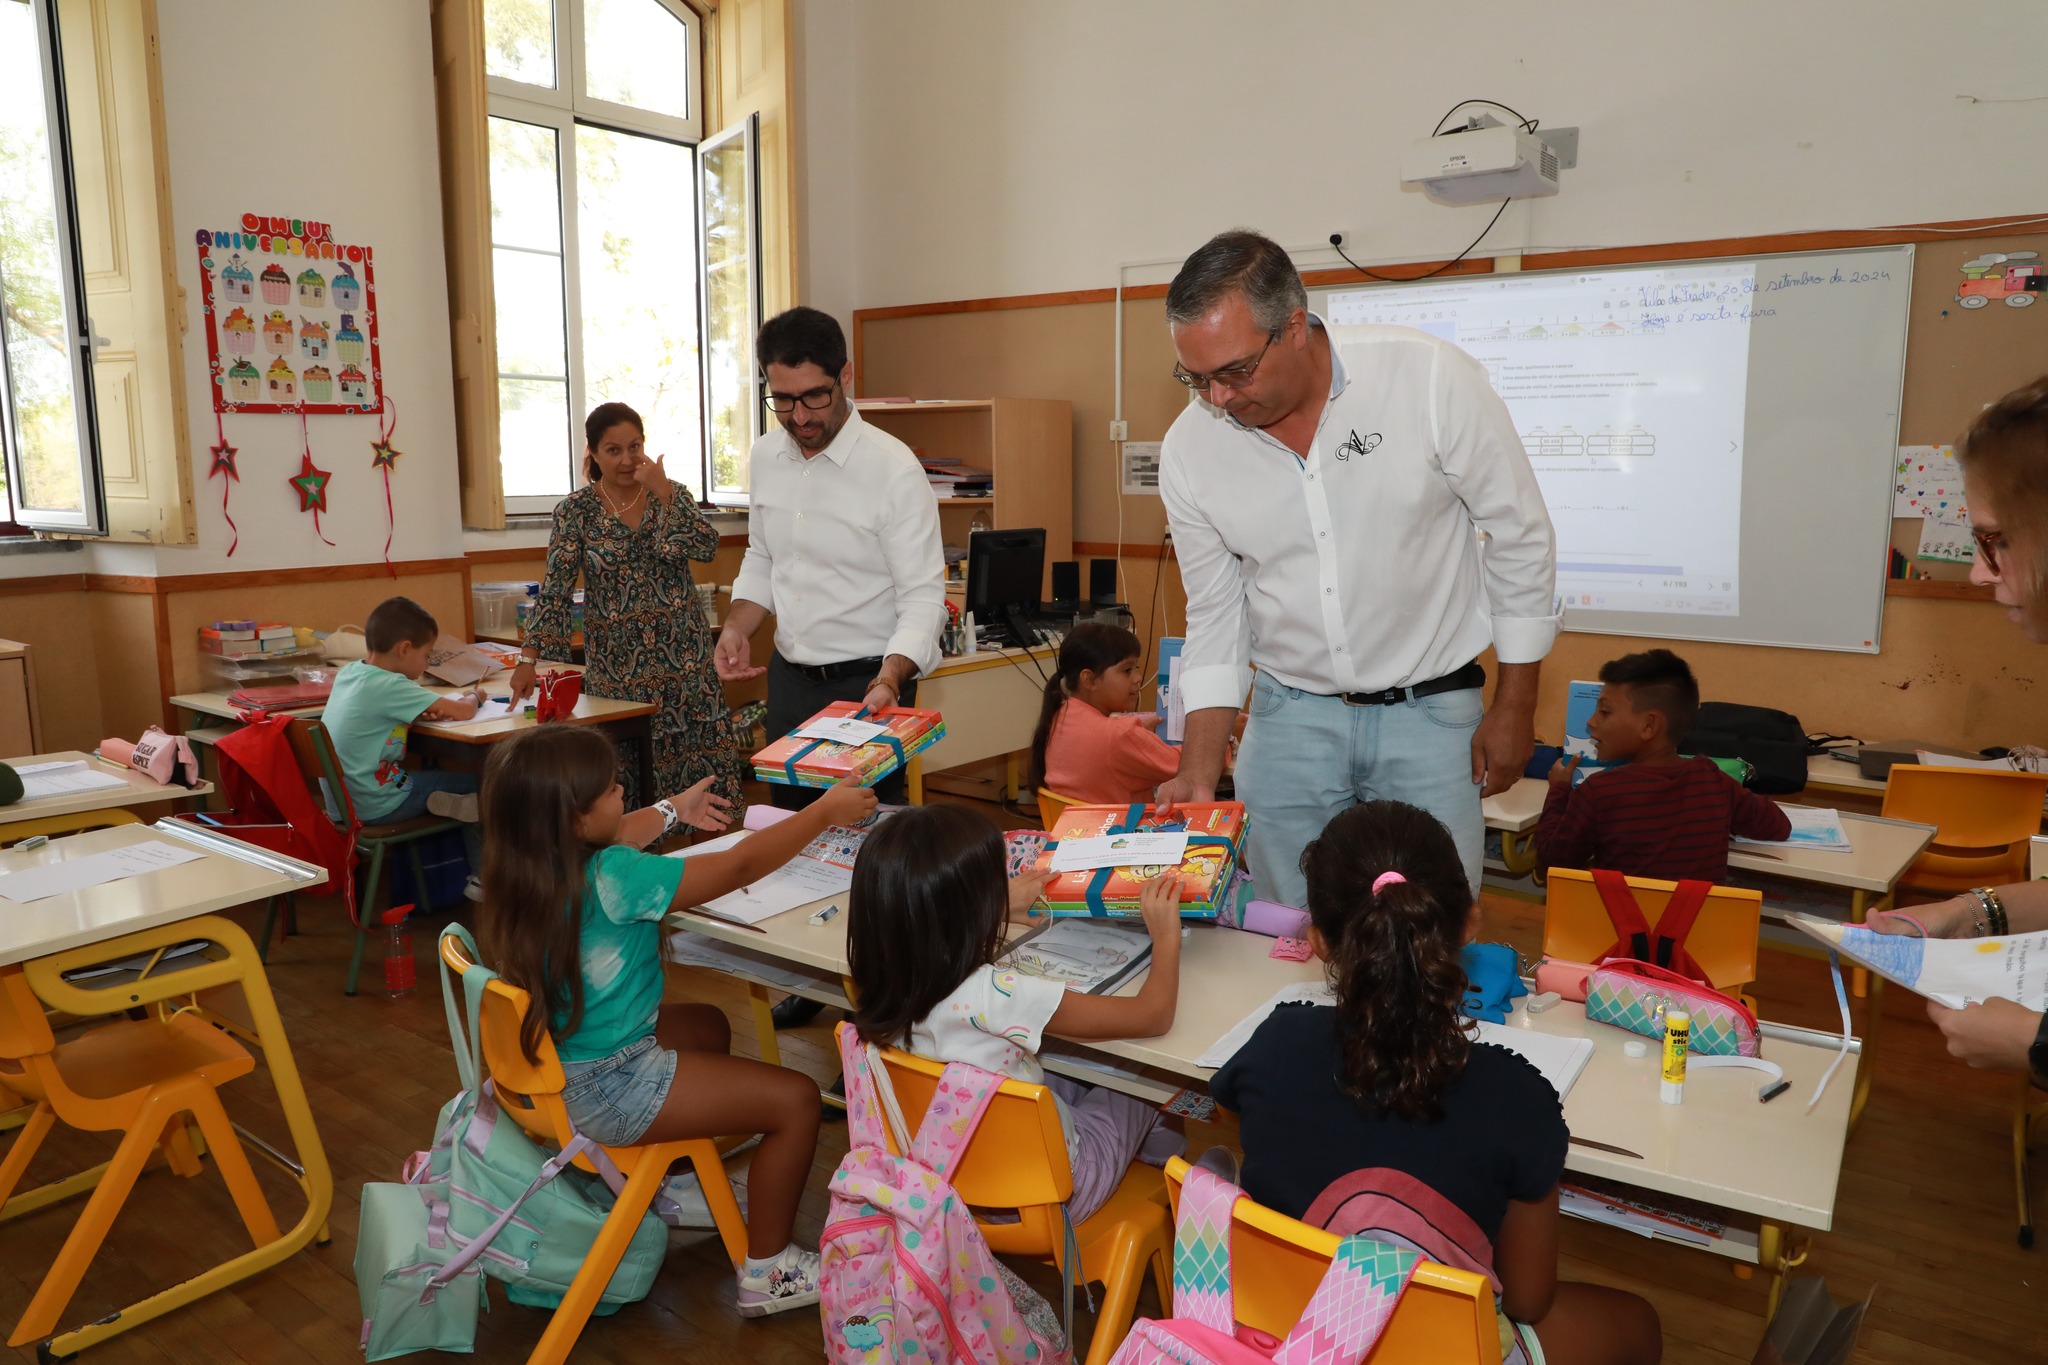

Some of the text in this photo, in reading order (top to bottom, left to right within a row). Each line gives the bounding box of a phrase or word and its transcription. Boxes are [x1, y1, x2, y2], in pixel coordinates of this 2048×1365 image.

[241, 212, 323, 239] O MEU
[195, 228, 374, 267] ANIVERSÁRIO!
[1721, 285, 1739, 296] 20
[1743, 278, 1761, 294] de
[1765, 272, 1826, 293] setembro
[1829, 268, 1844, 284] de
[1849, 271, 1892, 283] 2024
[1689, 304, 1778, 325] sexta-feira
[136, 742, 157, 757] SUGAR
[1670, 1028, 1689, 1037] UHU
